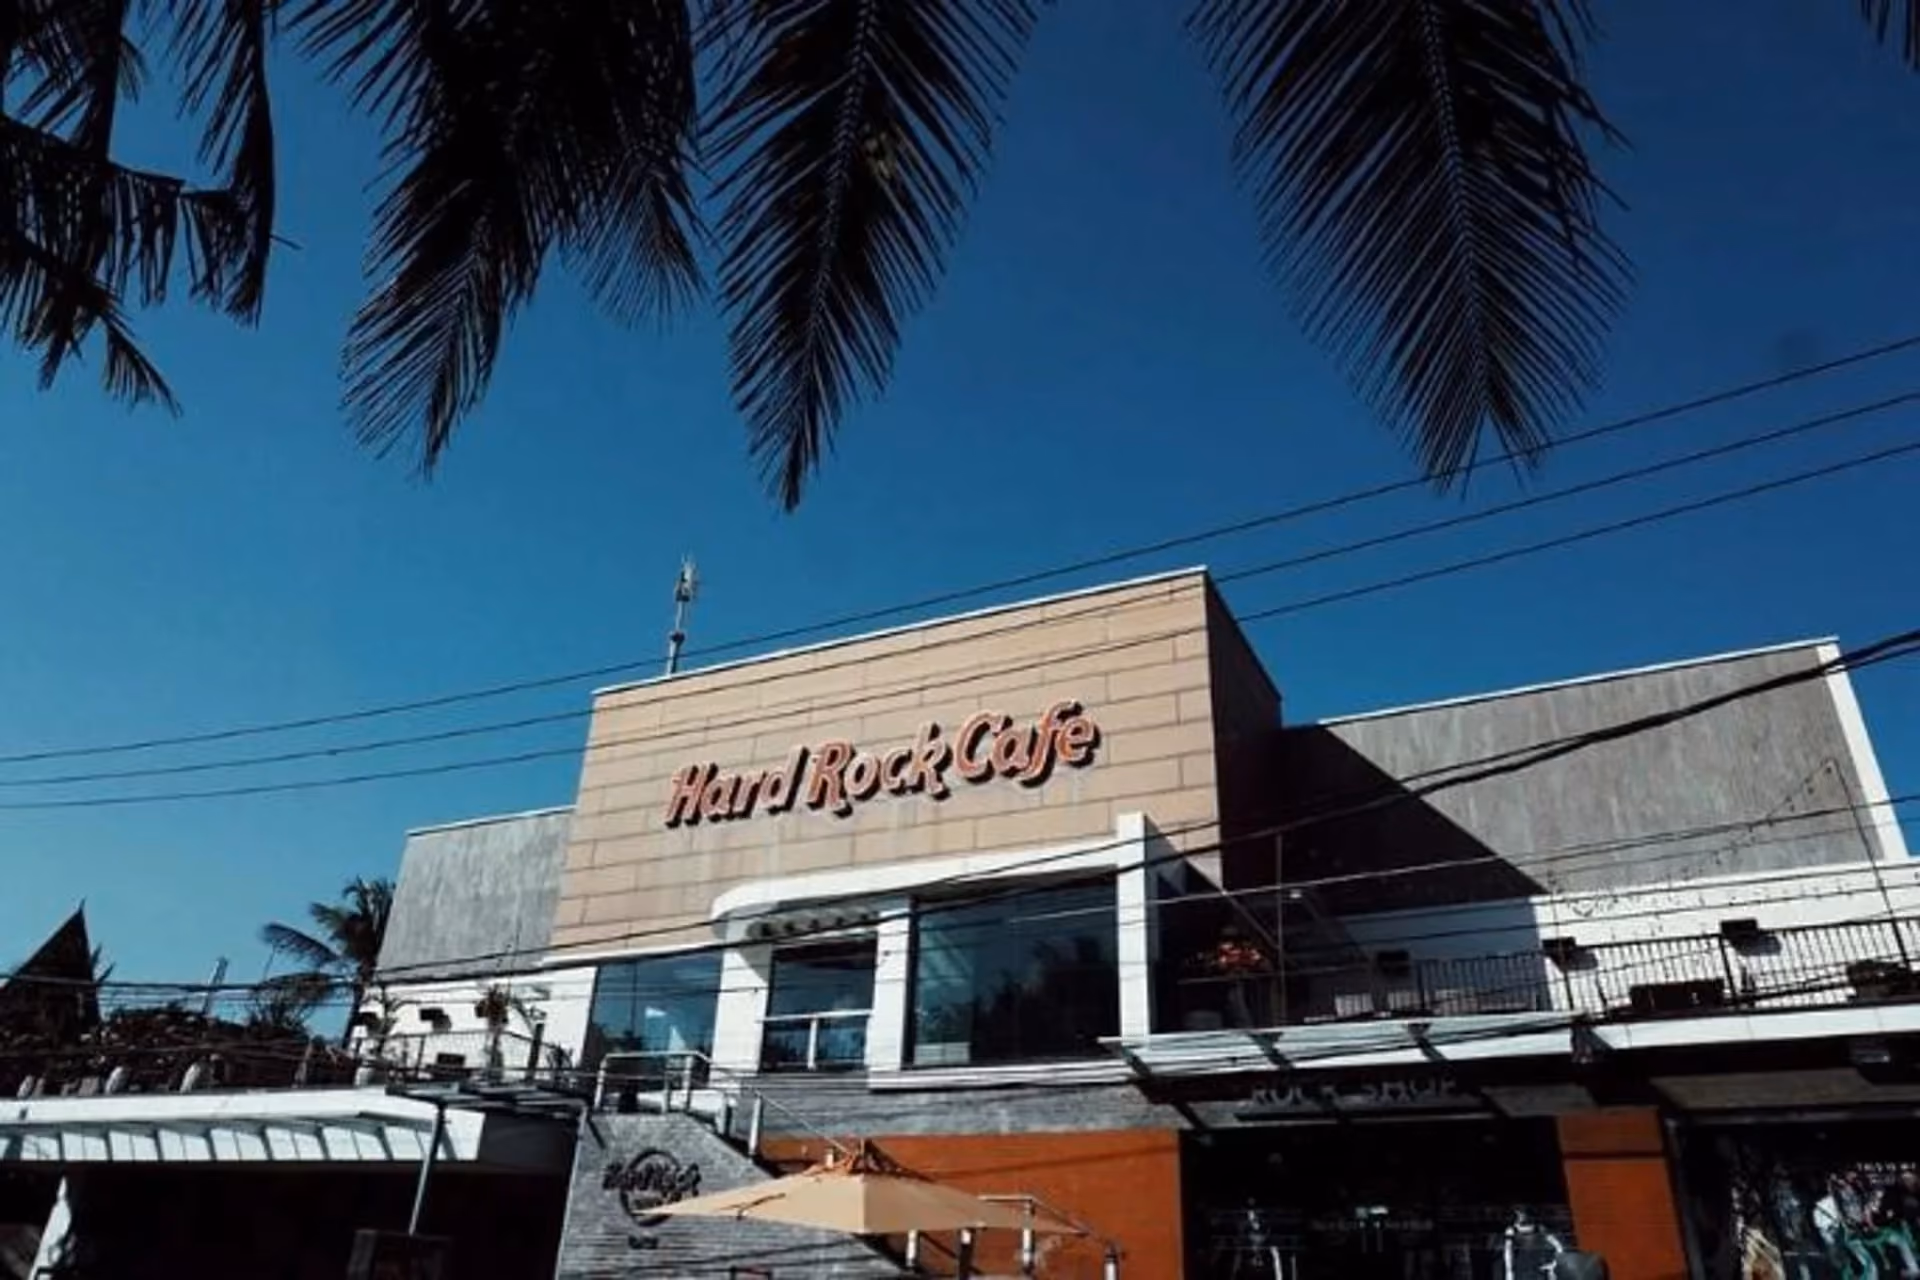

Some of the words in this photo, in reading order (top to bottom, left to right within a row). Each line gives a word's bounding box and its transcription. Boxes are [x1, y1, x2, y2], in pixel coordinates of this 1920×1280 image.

[665, 744, 808, 828] Hard
[804, 720, 953, 818] Rock
[950, 698, 1102, 788] Cafe
